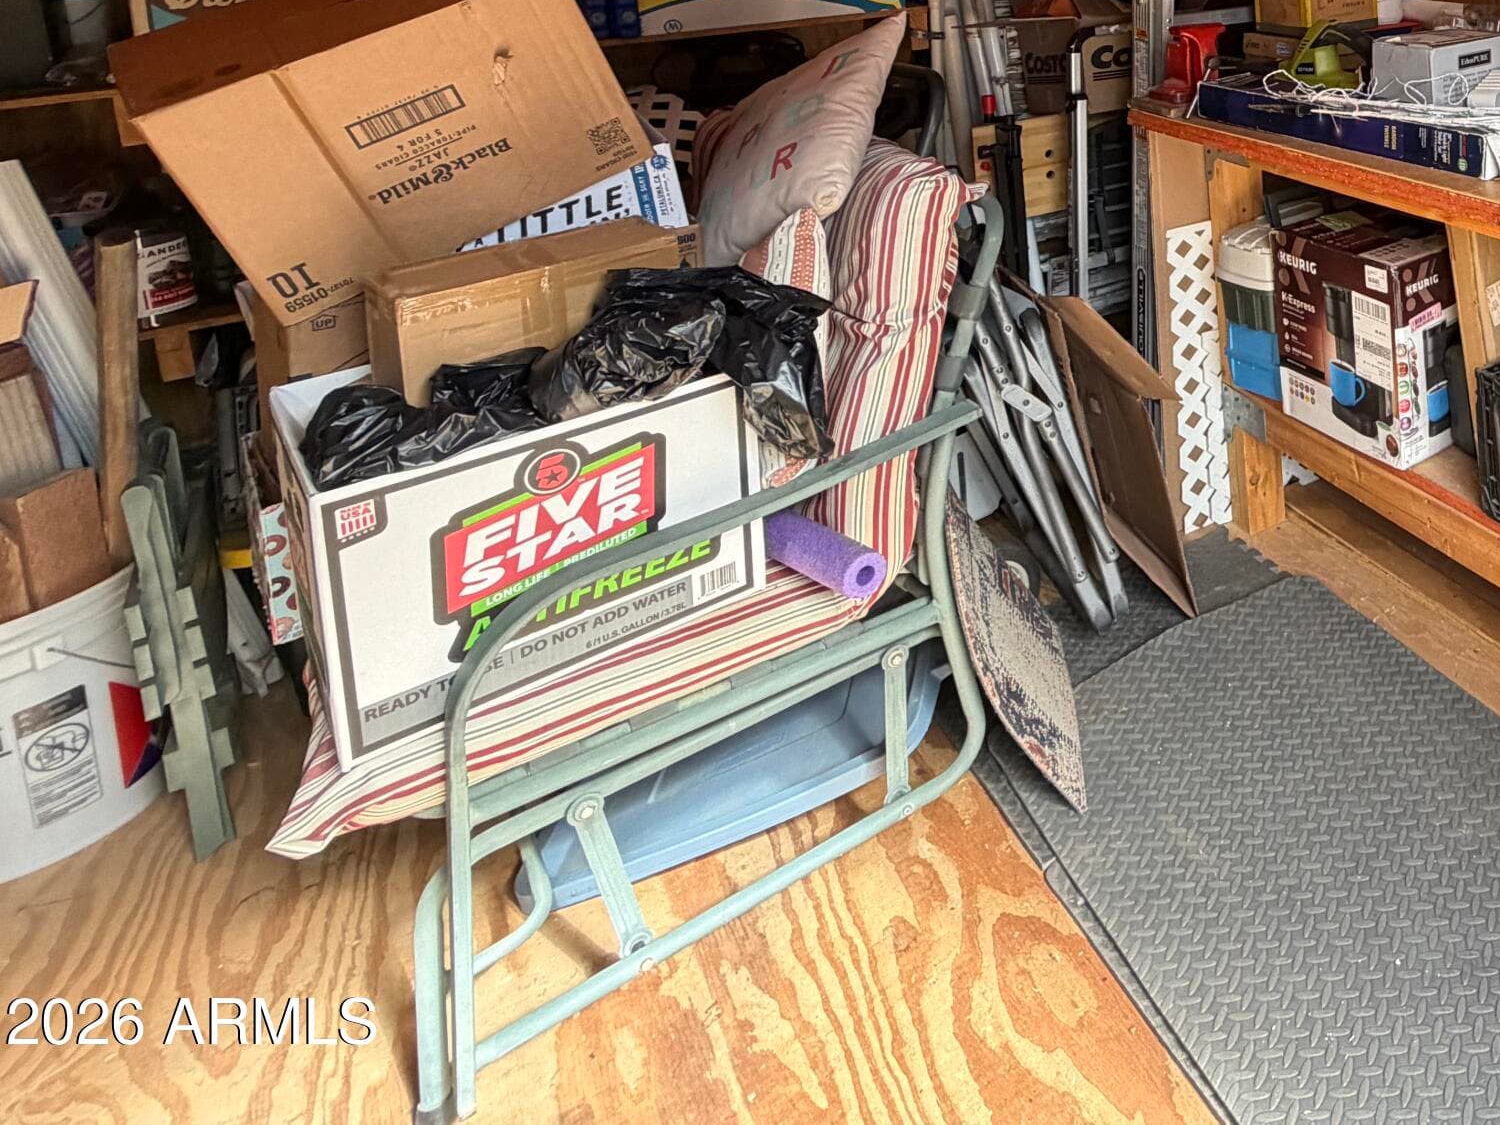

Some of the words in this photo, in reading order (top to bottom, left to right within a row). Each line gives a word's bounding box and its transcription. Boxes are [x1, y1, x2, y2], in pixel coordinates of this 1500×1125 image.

[1025, 51, 1068, 74] COSTC
[408, 133, 432, 147] FOR
[375, 152, 410, 171] CIGARS
[415, 147, 450, 168] JAZZ
[1277, 250, 1318, 276] KEURIG
[1405, 273, 1440, 297] KEURIG
[1281, 290, 1316, 314] K-Express
[313, 318, 332, 329] UP
[340, 506, 372, 521] USA
[463, 455, 646, 569] FIVE
[458, 492, 641, 597] STAR
[485, 584, 523, 608] LONG
[524, 569, 551, 592] LIFE
[563, 527, 637, 569] PREDILUTED
[619, 617, 661, 640] GALLON
[364, 689, 433, 724] READY
[519, 637, 548, 660] DO
[551, 624, 588, 647] NOT
[597, 607, 629, 630] ADD
[631, 581, 687, 613] WATER
